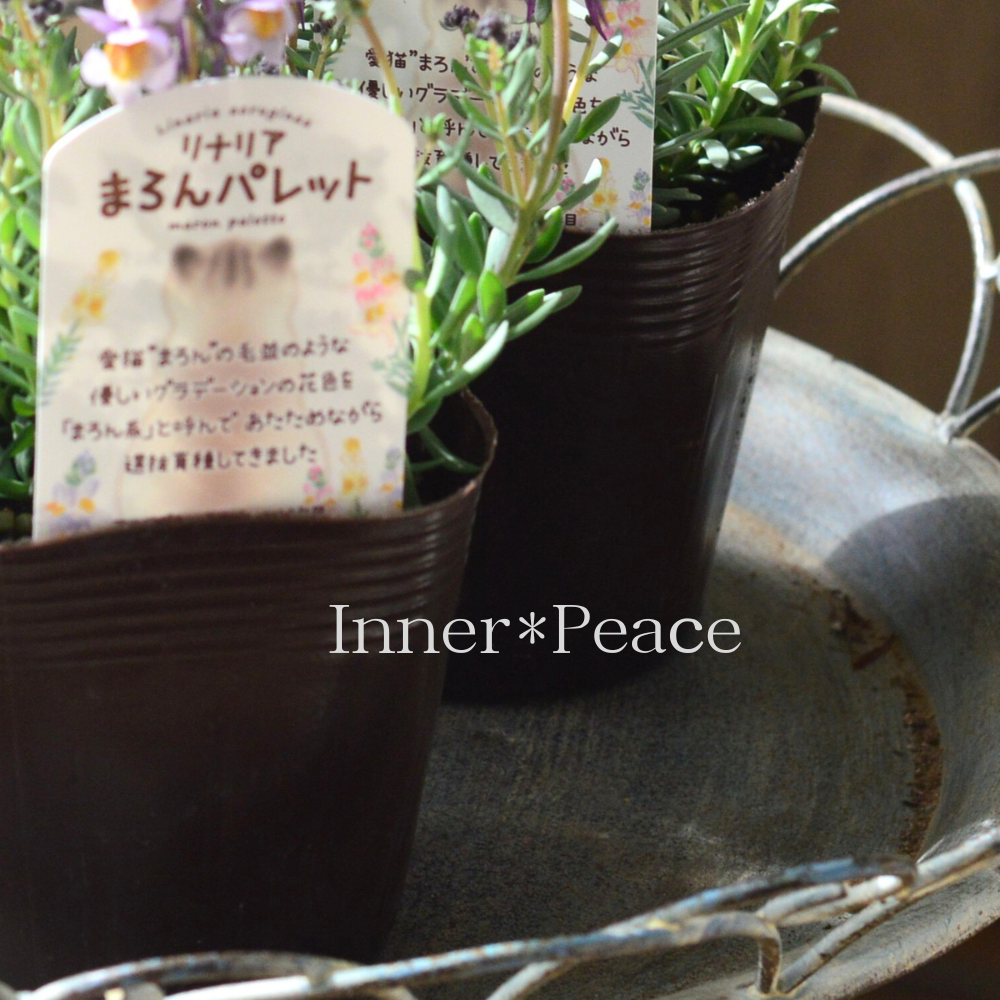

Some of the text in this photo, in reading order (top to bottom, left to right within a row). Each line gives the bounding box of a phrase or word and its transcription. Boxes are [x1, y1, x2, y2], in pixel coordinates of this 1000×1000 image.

[182, 129, 286, 162] リナリア
[98, 159, 372, 218] まろんパレット
